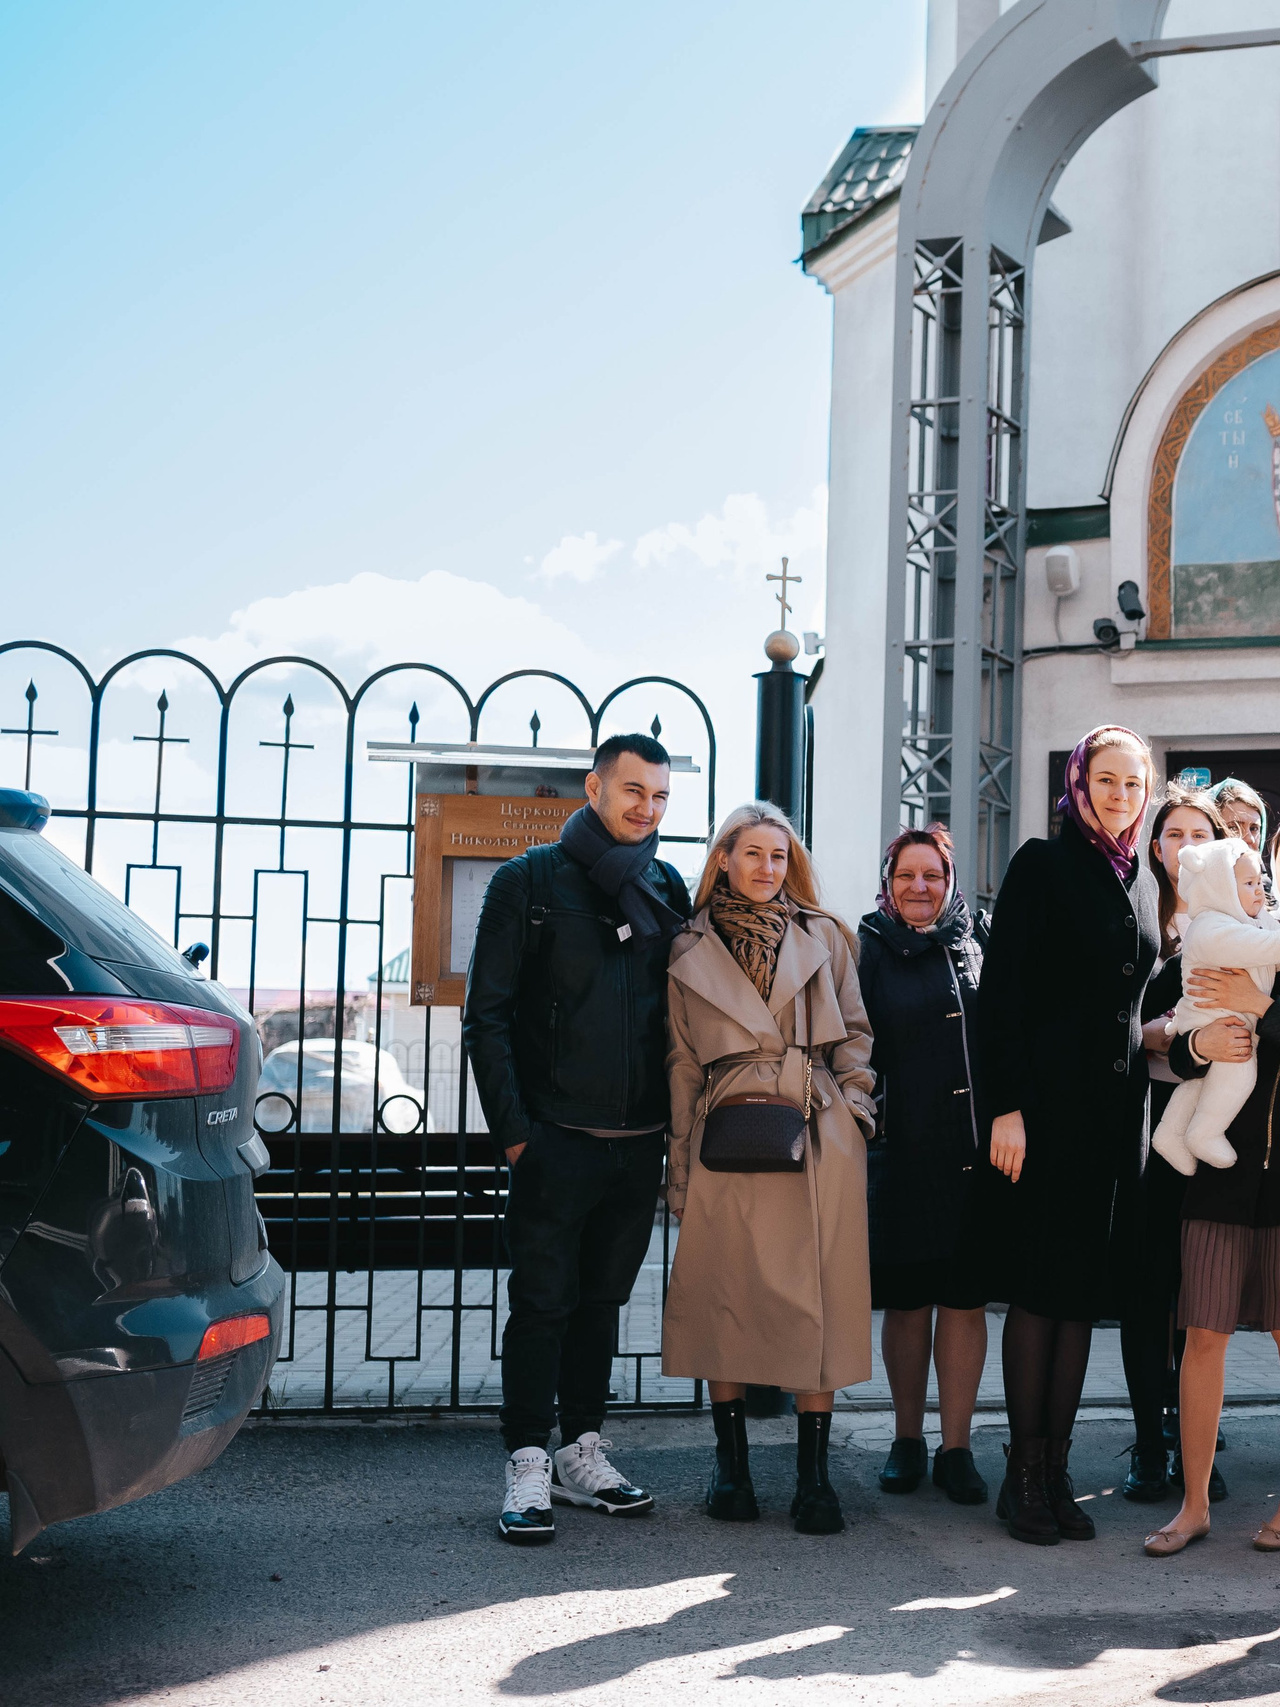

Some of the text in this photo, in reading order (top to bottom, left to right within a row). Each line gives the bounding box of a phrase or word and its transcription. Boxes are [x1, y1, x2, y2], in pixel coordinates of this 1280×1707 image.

[500, 802, 569, 819] Церковь
[450, 832, 519, 847] Николая
[207, 1106, 238, 1126] CRETA
